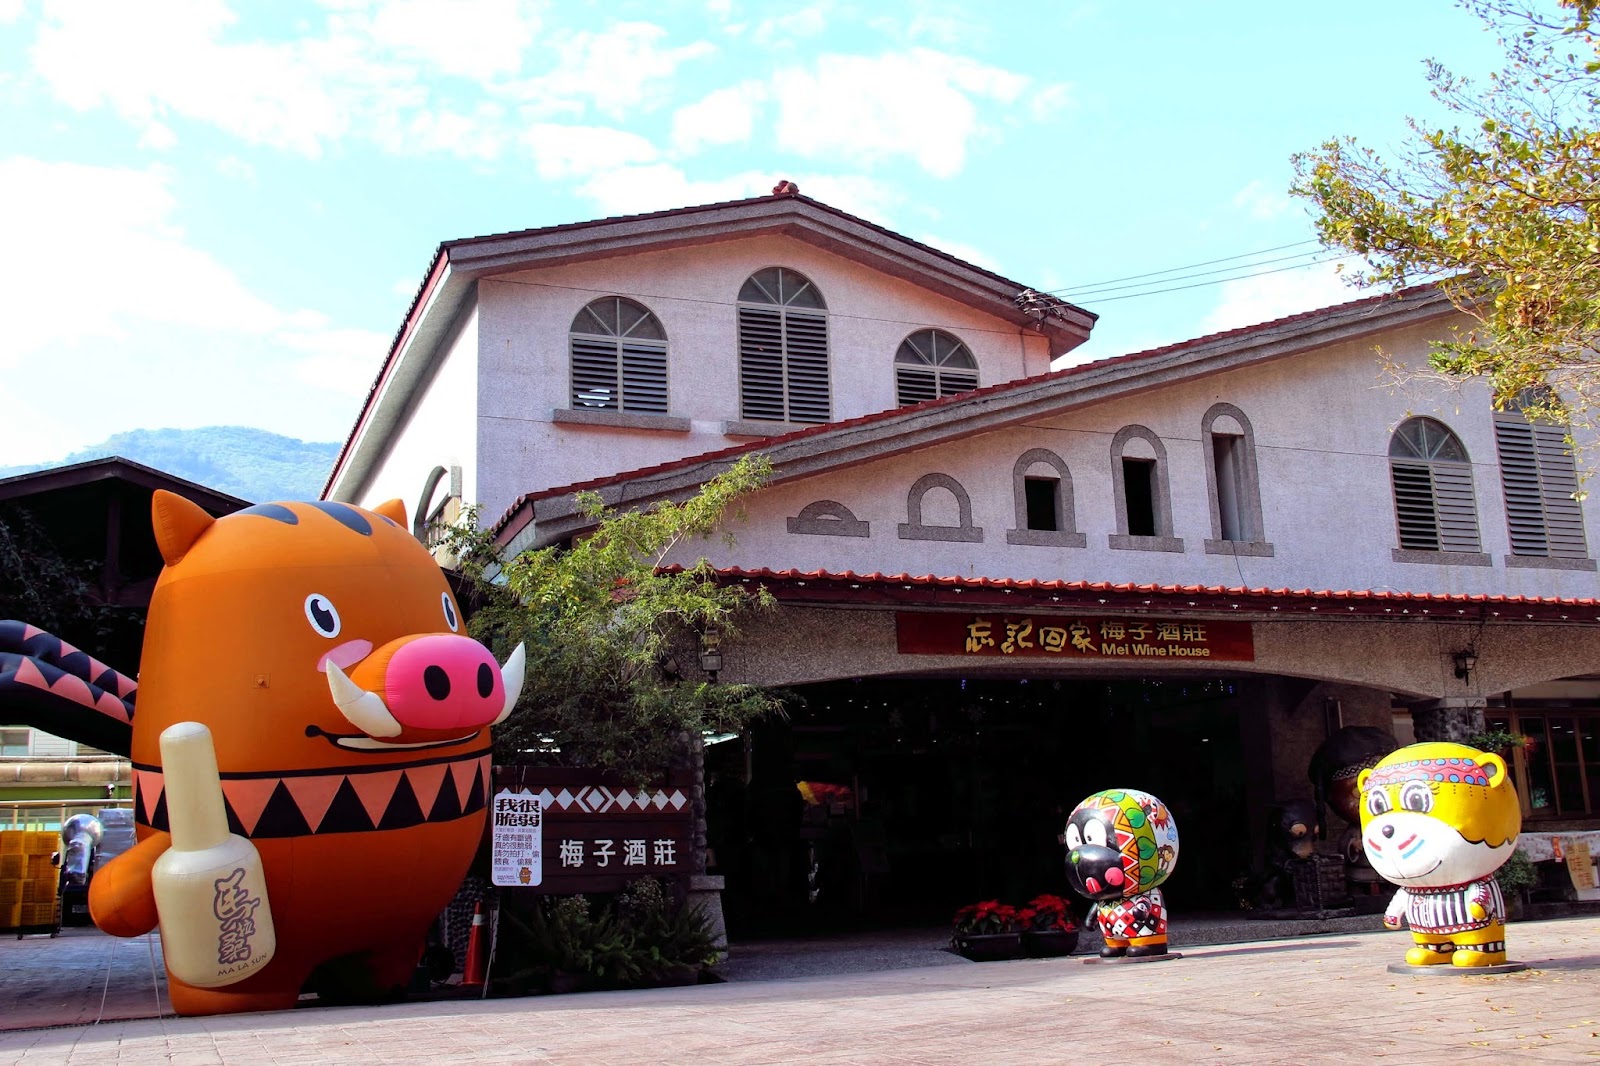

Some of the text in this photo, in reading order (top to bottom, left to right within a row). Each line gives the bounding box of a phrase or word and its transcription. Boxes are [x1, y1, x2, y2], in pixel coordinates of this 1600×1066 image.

[966, 618, 1207, 653] 忘記回家 梅子酒莊
[1102, 643, 1210, 657] Mei Wine House
[496, 798, 540, 812] 我很
[495, 813, 540, 827] 脆弱
[559, 839, 677, 867] 梅子酒莊
[218, 953, 267, 976] MA LA SUN
